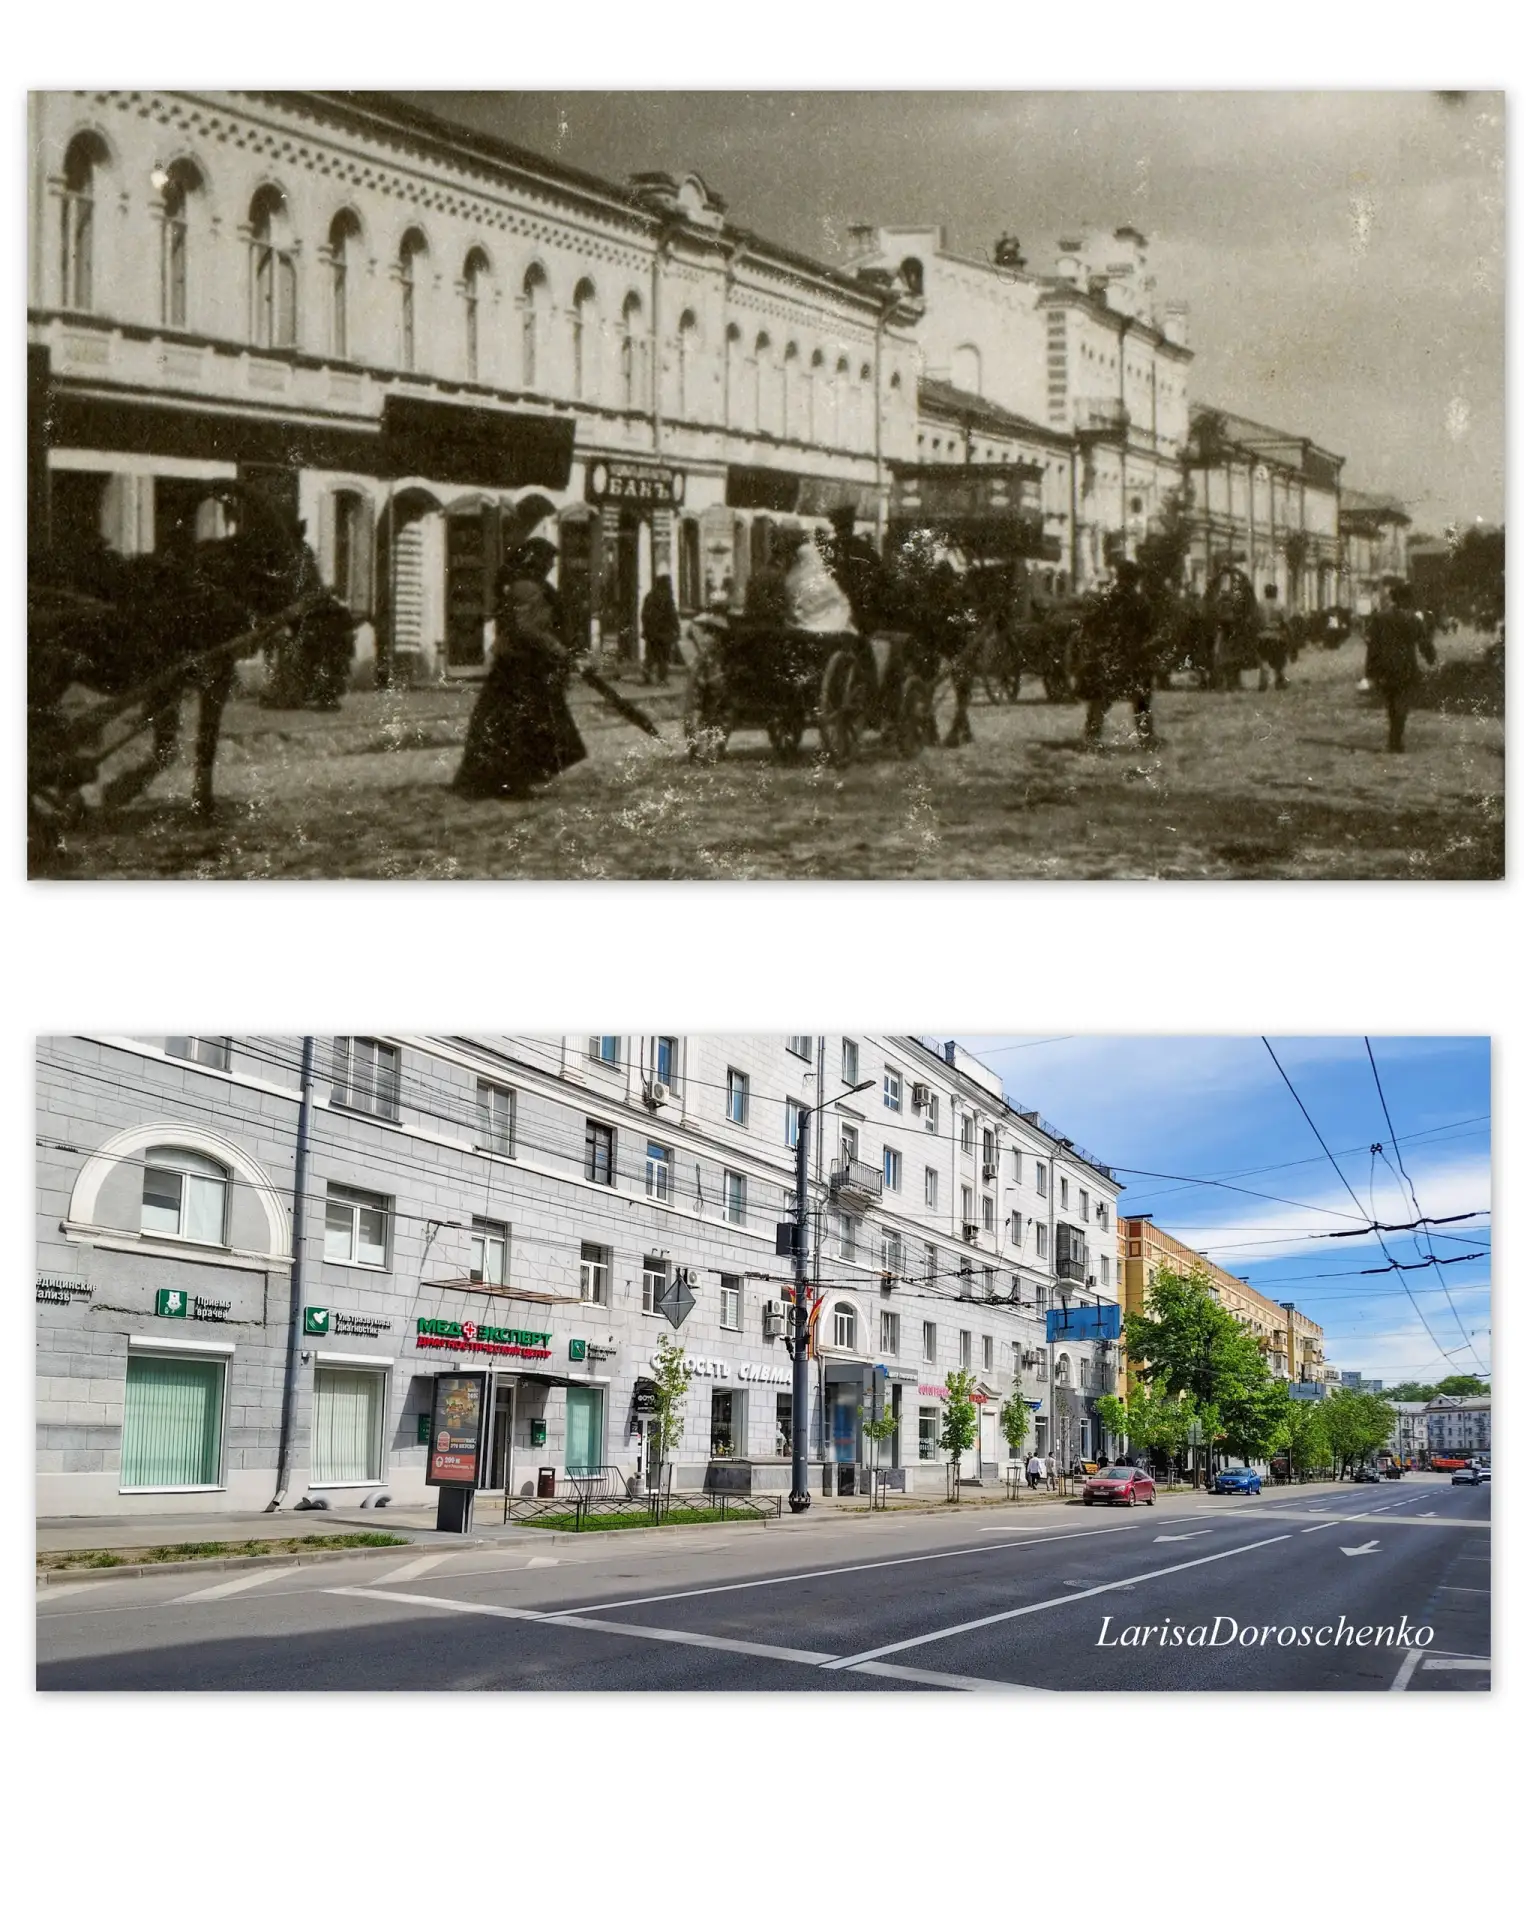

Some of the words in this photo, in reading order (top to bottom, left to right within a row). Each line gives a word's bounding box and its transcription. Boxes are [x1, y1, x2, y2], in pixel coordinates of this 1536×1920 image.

[36, 1289, 73, 1302] ализы
[196, 1307, 228, 1319] врачей
[416, 1317, 463, 1336] МЕД
[477, 1325, 553, 1347] ЭКСПЕРТ
[416, 1336, 522, 1357] ДИАГНОСТИЧЕСКИЙ
[521, 1348, 553, 1360] ЦЕНТР
[650, 1350, 731, 1377] ФТОСЕТЬ
[738, 1362, 793, 1385] СИВМА
